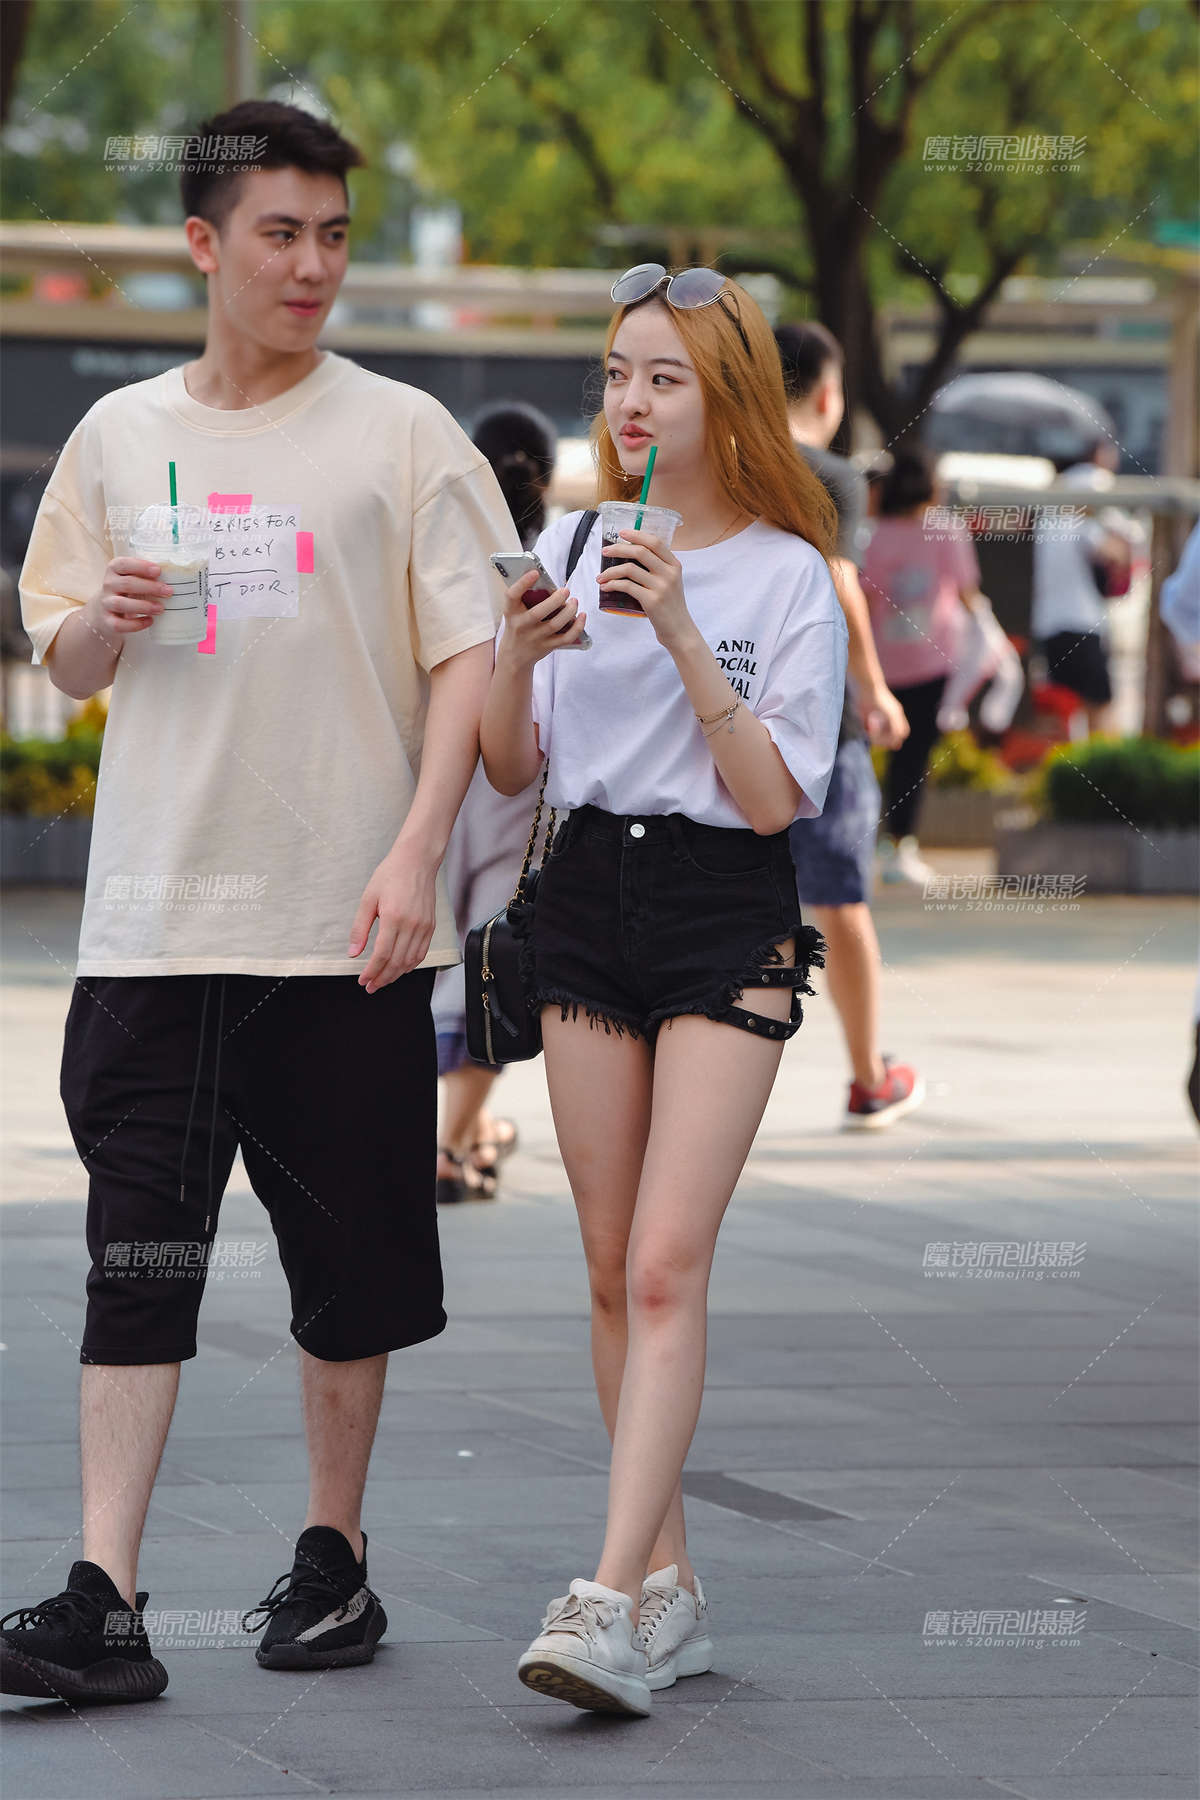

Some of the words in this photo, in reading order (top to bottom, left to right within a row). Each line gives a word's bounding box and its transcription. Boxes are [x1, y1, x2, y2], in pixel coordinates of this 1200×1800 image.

[266, 515, 297, 529] FOR
[716, 640, 755, 655] ANTI
[715, 657, 758, 676] OCIAL
[726, 677, 751, 701] IAL
